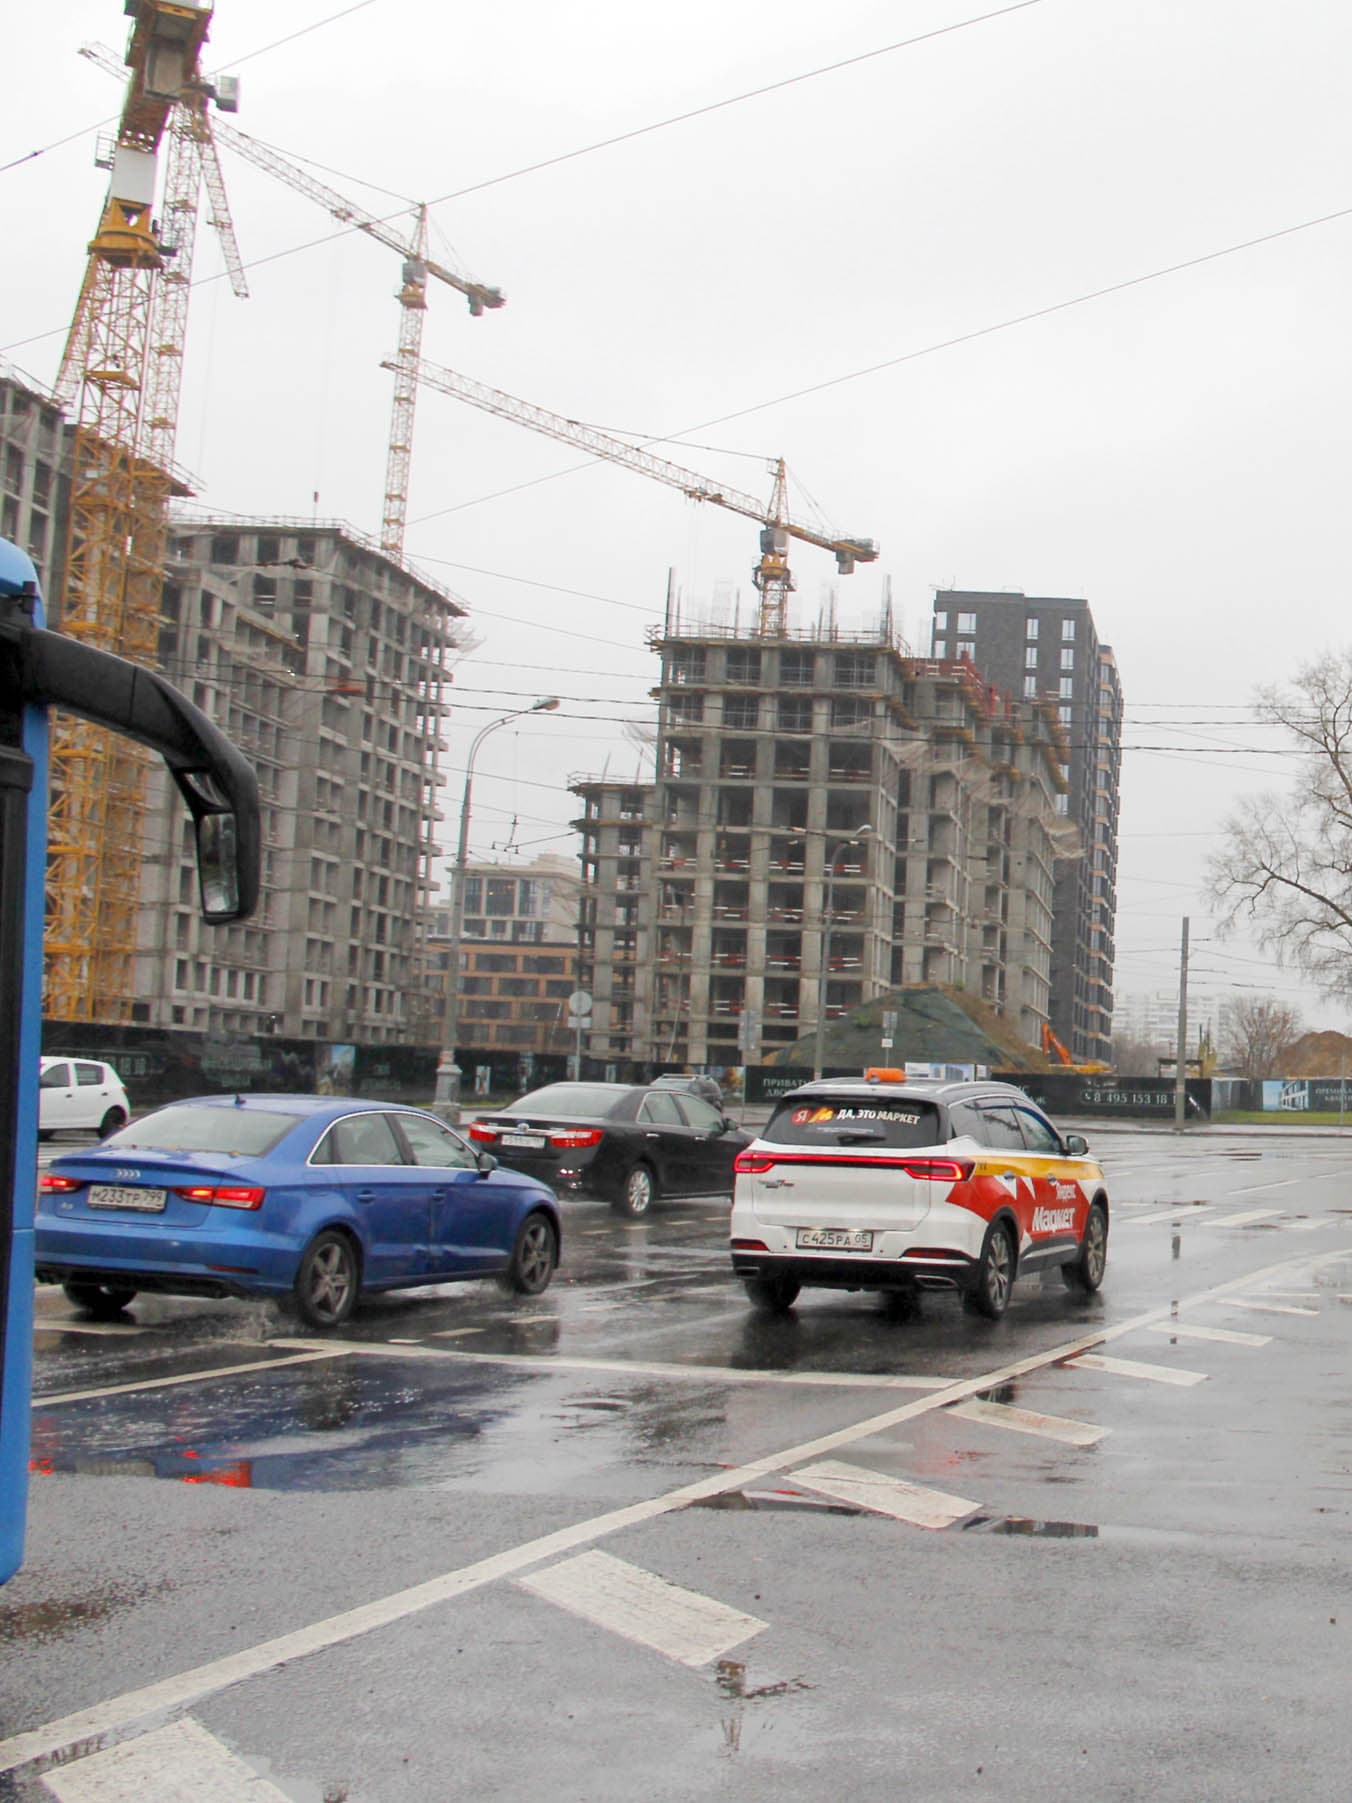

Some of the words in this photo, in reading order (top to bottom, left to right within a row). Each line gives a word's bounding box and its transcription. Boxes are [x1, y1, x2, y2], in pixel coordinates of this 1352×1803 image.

[837, 1108, 855, 1120] ДА,
[856, 1110, 876, 1119] ЭТО
[876, 1110, 920, 1125] МАРКЕТ
[1031, 1206, 1076, 1233] Маркет
